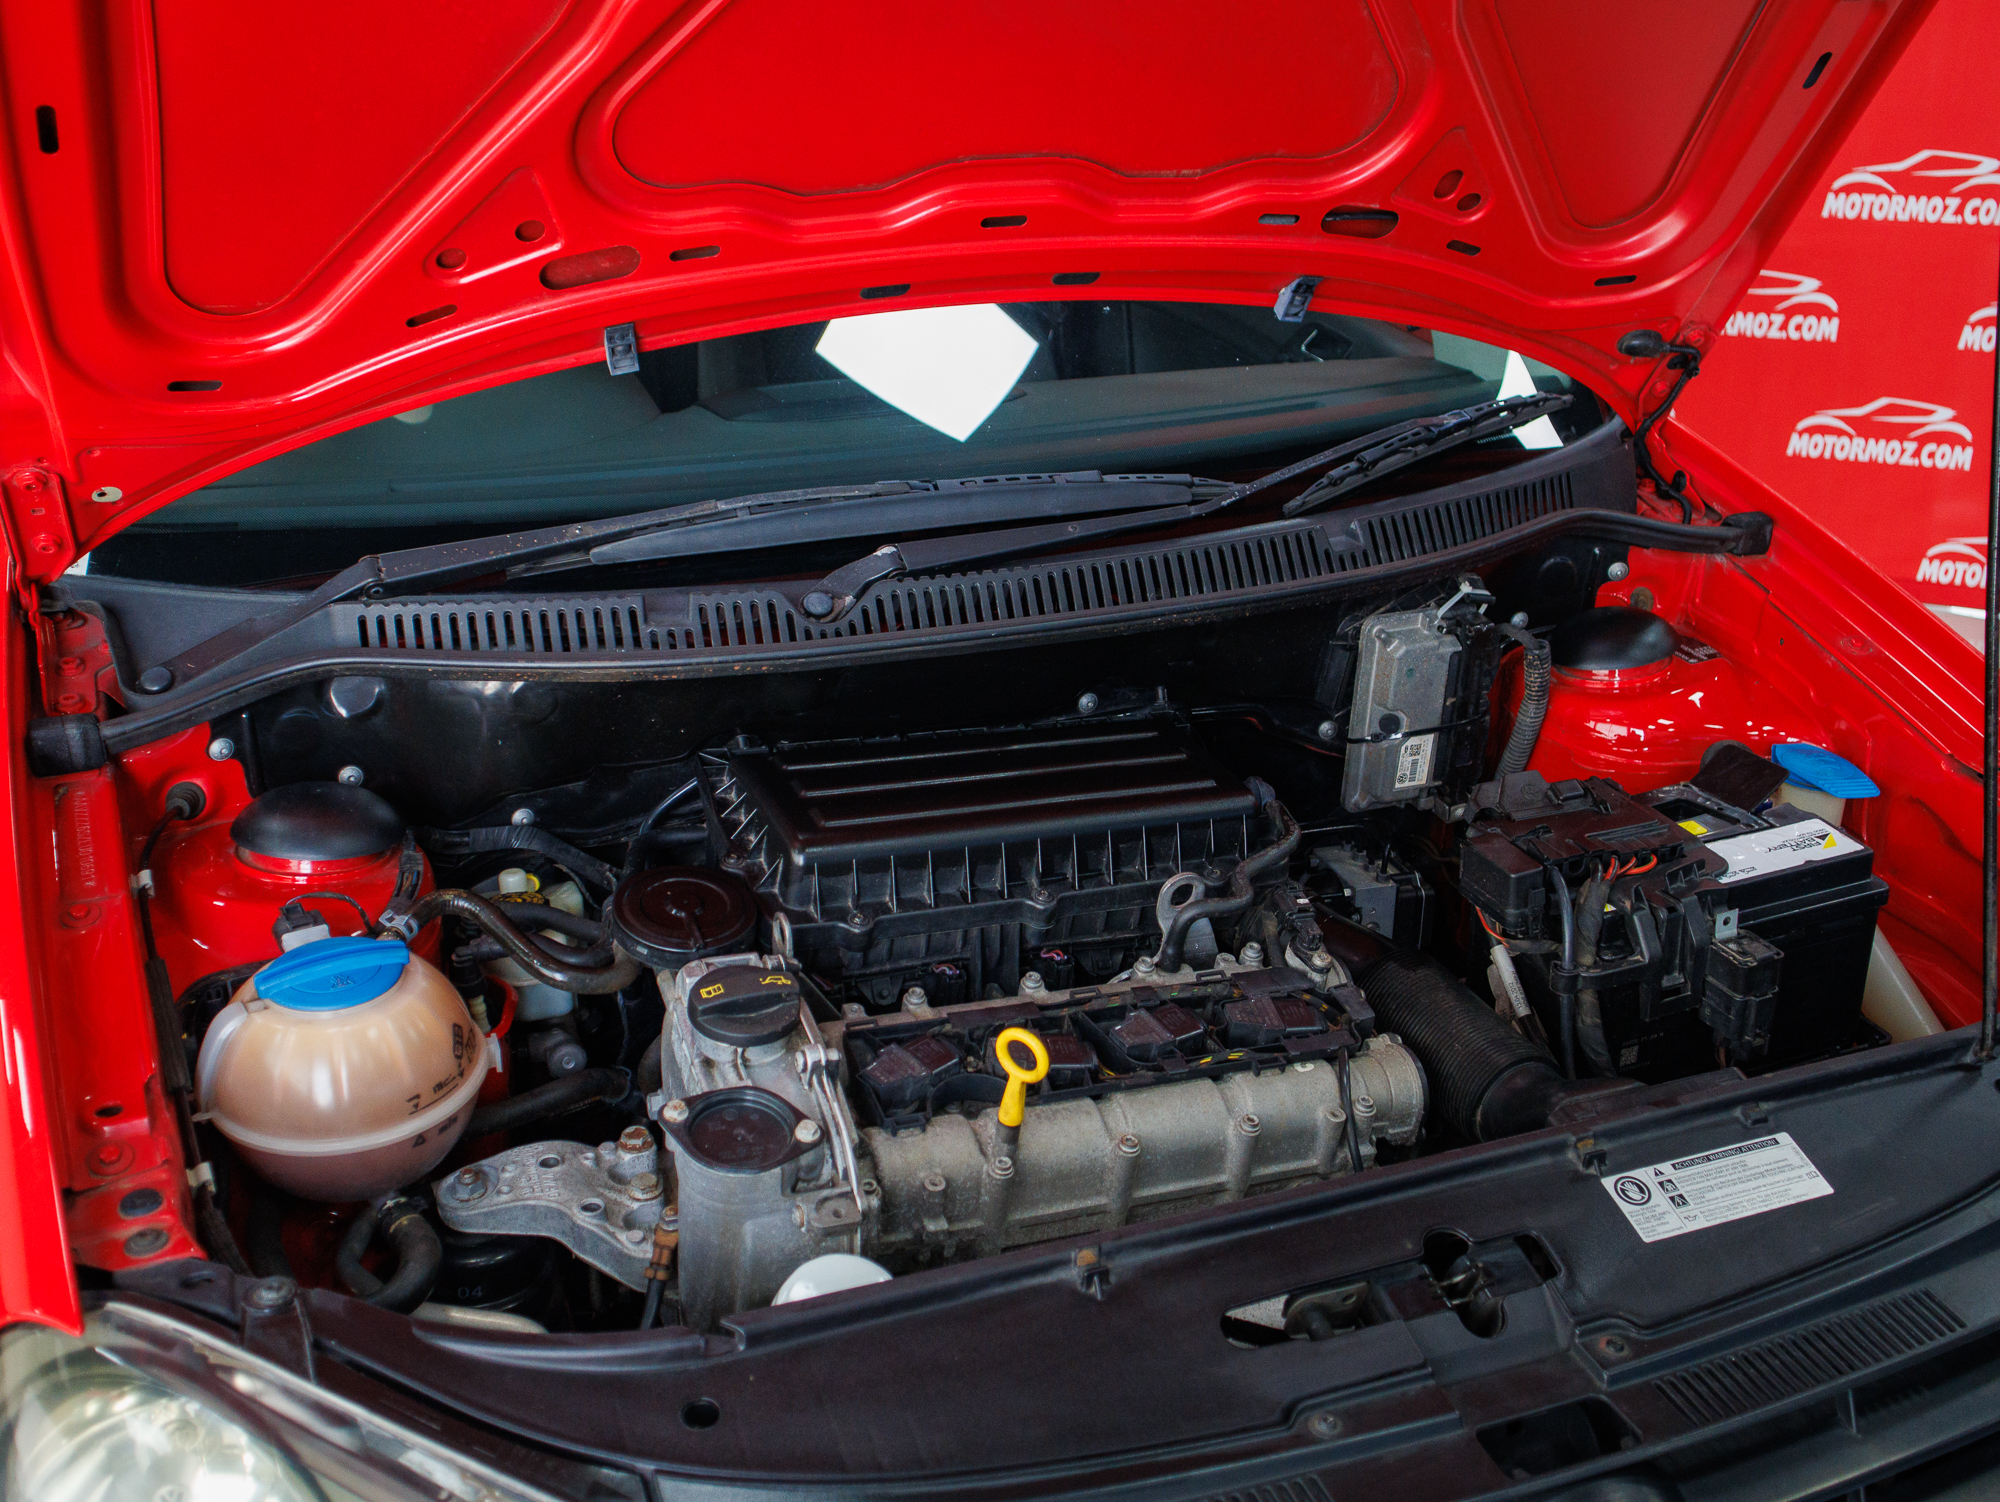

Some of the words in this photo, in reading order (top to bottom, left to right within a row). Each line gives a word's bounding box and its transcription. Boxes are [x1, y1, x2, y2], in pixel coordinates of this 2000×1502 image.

[1821, 192, 2000, 226] MOTORMOZ.CO
[1720, 311, 1840, 343] RMOZ.COM
[1785, 431, 1974, 472] MOTORMOZ.COM
[1675, 1157, 1708, 1170] ACHTUNG!
[1708, 1148, 1741, 1161] WARNING!
[1741, 1139, 1777, 1153] ATTENTION!
